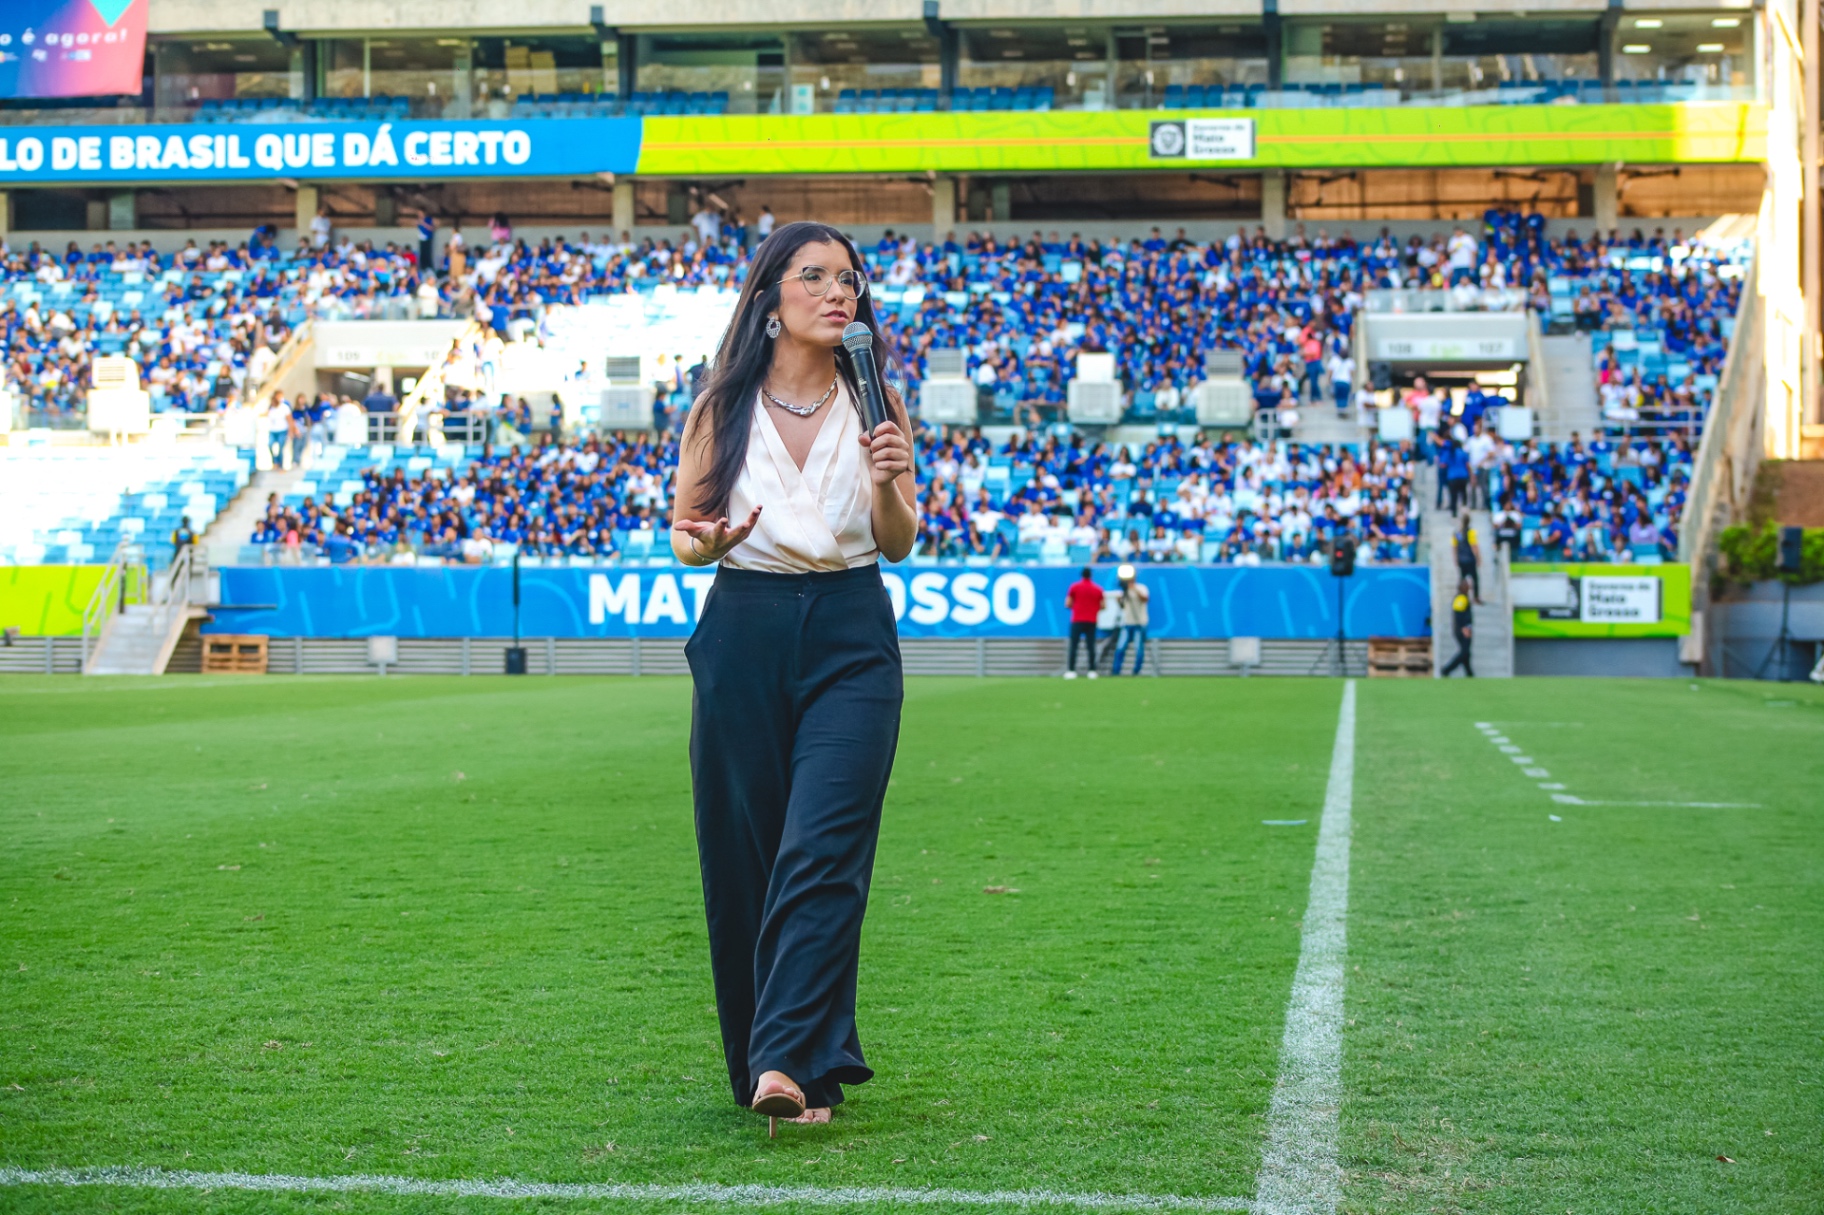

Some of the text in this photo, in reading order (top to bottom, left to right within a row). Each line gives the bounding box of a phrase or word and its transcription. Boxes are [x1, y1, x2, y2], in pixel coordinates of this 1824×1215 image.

[45, 28, 127, 49] agora!
[0, 123, 531, 171] LO DE BRASIL QUE DÁ CERTO
[1589, 593, 1626, 604] Mato
[1589, 605, 1639, 617] Grosso
